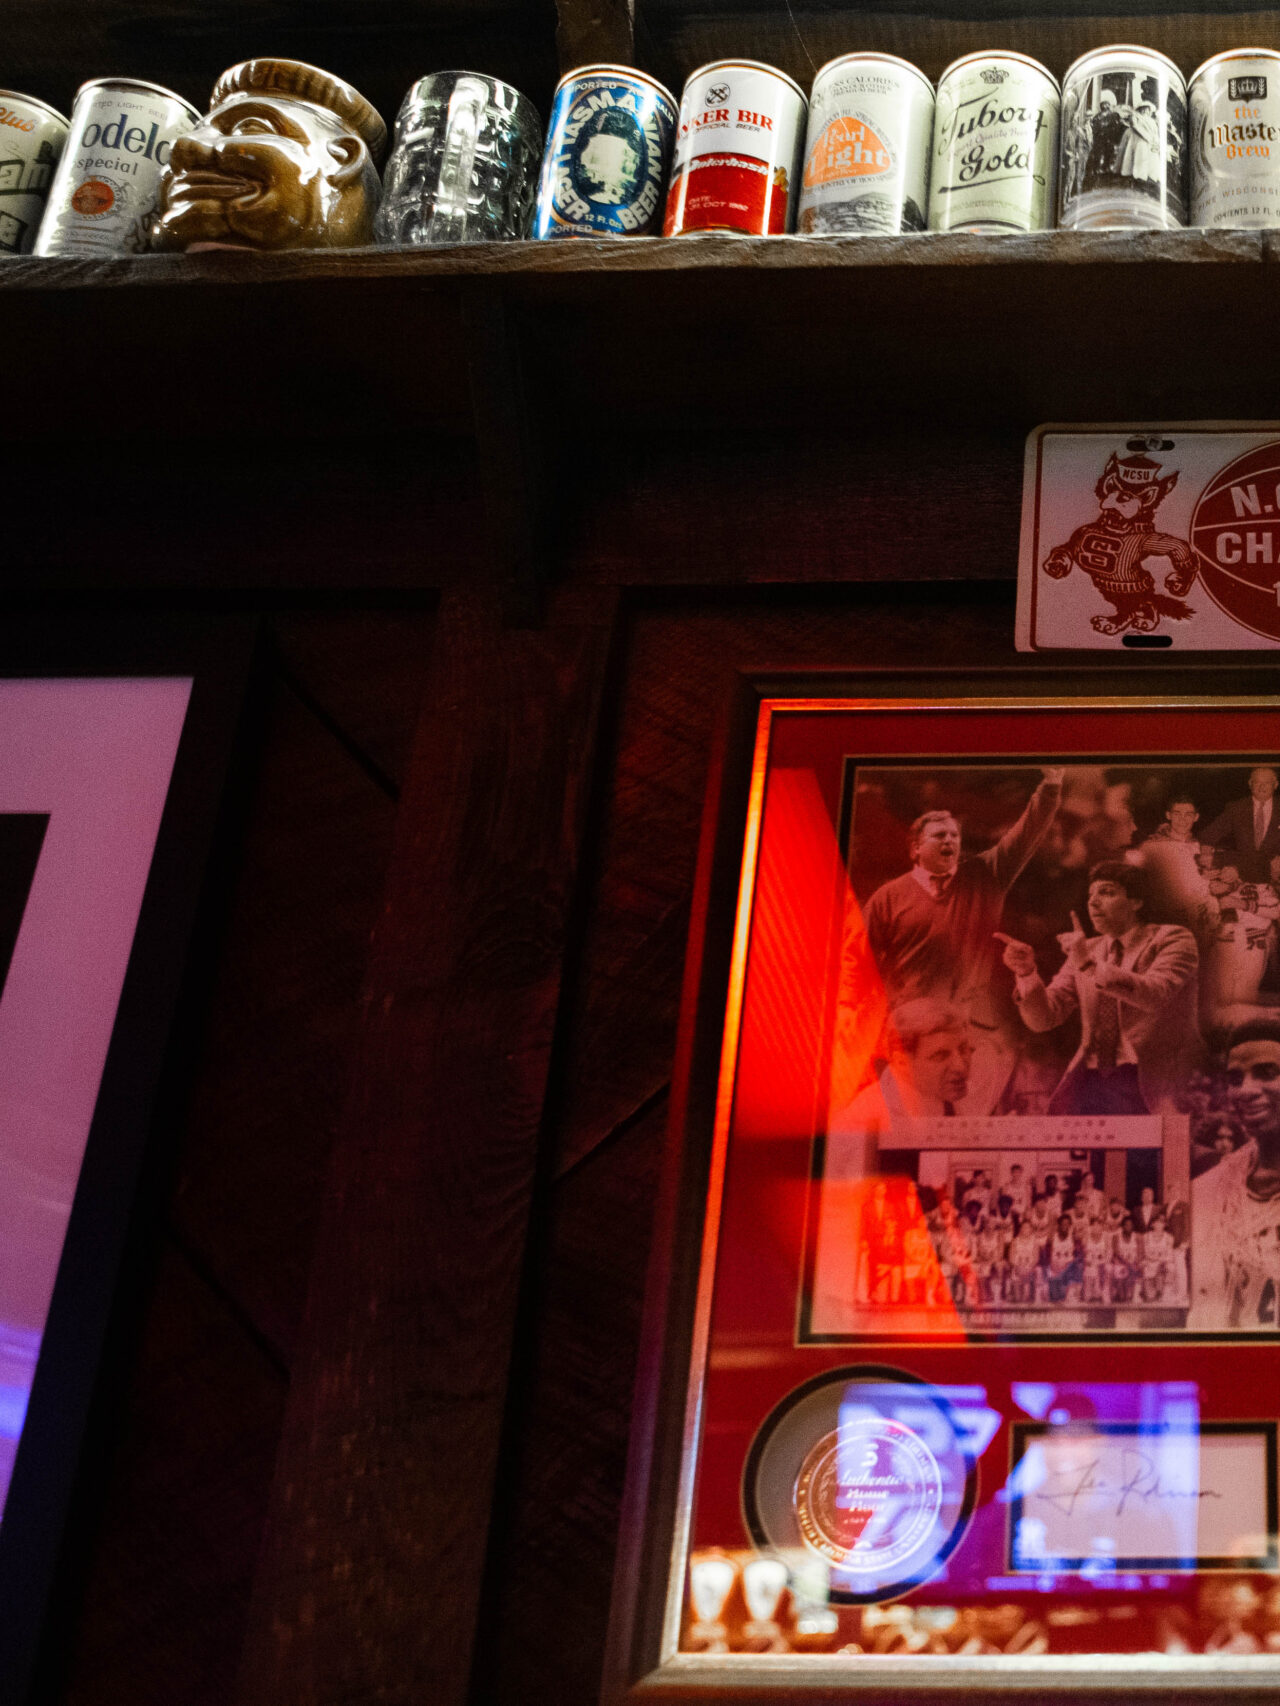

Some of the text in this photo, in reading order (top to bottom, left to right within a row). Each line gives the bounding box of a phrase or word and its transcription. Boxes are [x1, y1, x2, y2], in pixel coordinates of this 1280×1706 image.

[573, 81, 617, 92] PORTED
[737, 109, 774, 132] BIR
[1235, 104, 1260, 120] the
[1226, 143, 1271, 160] Brew
[76, 156, 139, 176] special
[616, 180, 660, 231] BEER
[1122, 470, 1150, 481] NCSU
